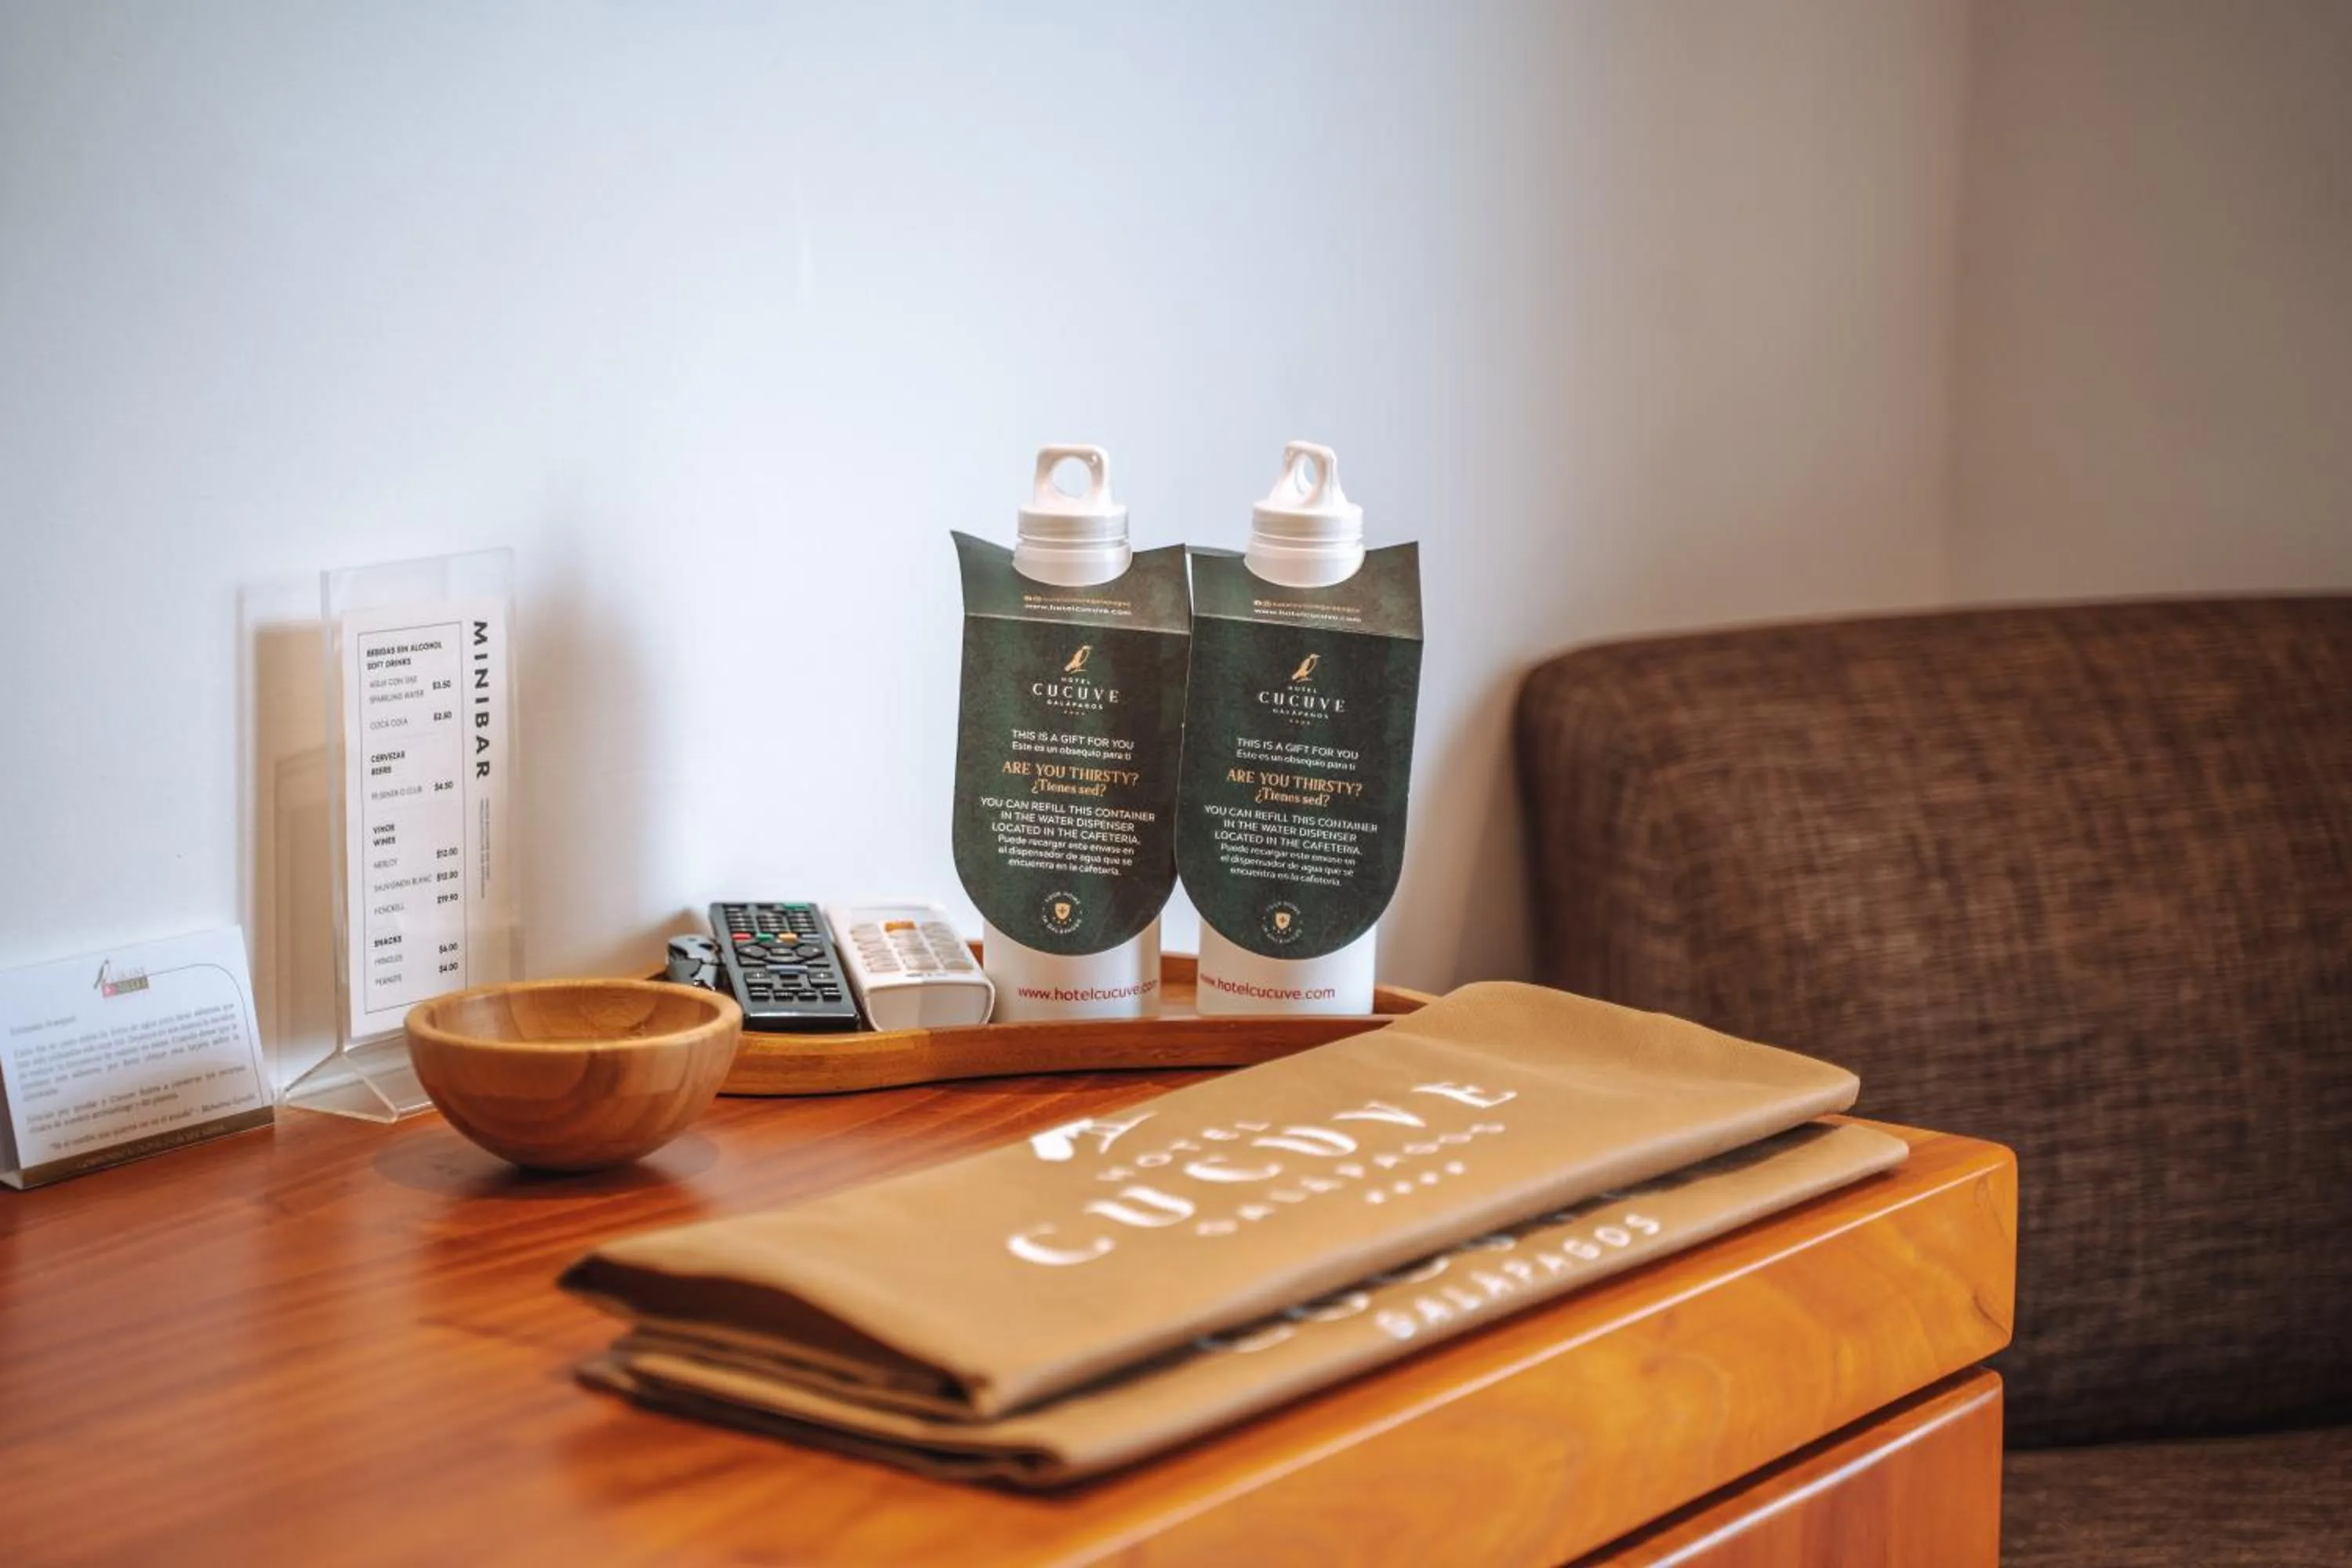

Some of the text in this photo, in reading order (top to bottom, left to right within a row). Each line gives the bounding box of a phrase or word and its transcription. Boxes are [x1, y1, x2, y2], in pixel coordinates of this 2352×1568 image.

[474, 621, 490, 779] MINIBAR
[1033, 683, 1119, 703] CUCUVE
[1258, 691, 1346, 713] CUCUVE
[1012, 729, 1134, 750] THIS IS A GIFT FOR YOU
[1236, 737, 1359, 760] THIS IS A GIFT FOR YOU
[1012, 742, 1031, 751] Este
[1059, 746, 1101, 759] obsequio
[1103, 751, 1123, 760] para
[1236, 749, 1257, 760] Este
[1258, 752, 1269, 760] es
[1327, 760, 1347, 771] para
[1003, 760, 1139, 787] ARE YOU THIRSTY?
[1226, 768, 1363, 797] ARE YOU THIRSTY?
[1031, 778, 1107, 797] ¿Tienes sed?
[980, 797, 1155, 822] YOU CAN REFILL THIS CONTAINER
[1302, 793, 1330, 808] sed?
[1001, 811, 1134, 832] IN THE WATER DISPENSER
[1204, 804, 1377, 833] YOU CAN REFILL THIS CONTAINER
[992, 822, 1040, 835] LOCATED
[1044, 826, 1054, 836] IN
[1058, 828, 1077, 839] THE
[1215, 830, 1263, 844] LOCATED
[1266, 835, 1277, 845] IN
[1280, 837, 1300, 848] THE
[1224, 819, 1357, 843] IN THE WATER DISPENSER
[998, 835, 1026, 845] Puede
[1029, 837, 1066, 849] recargar
[1069, 842, 1087, 851] este
[1008, 858, 1054, 870] encuentra
[1056, 862, 1067, 871] en
[1009, 846, 1063, 859] dispensador
[1066, 851, 1077, 860] de
[1080, 854, 1102, 864] agua
[1301, 864, 1323, 875] agua
[1007, 1082, 1518, 1265] CUCUVE
